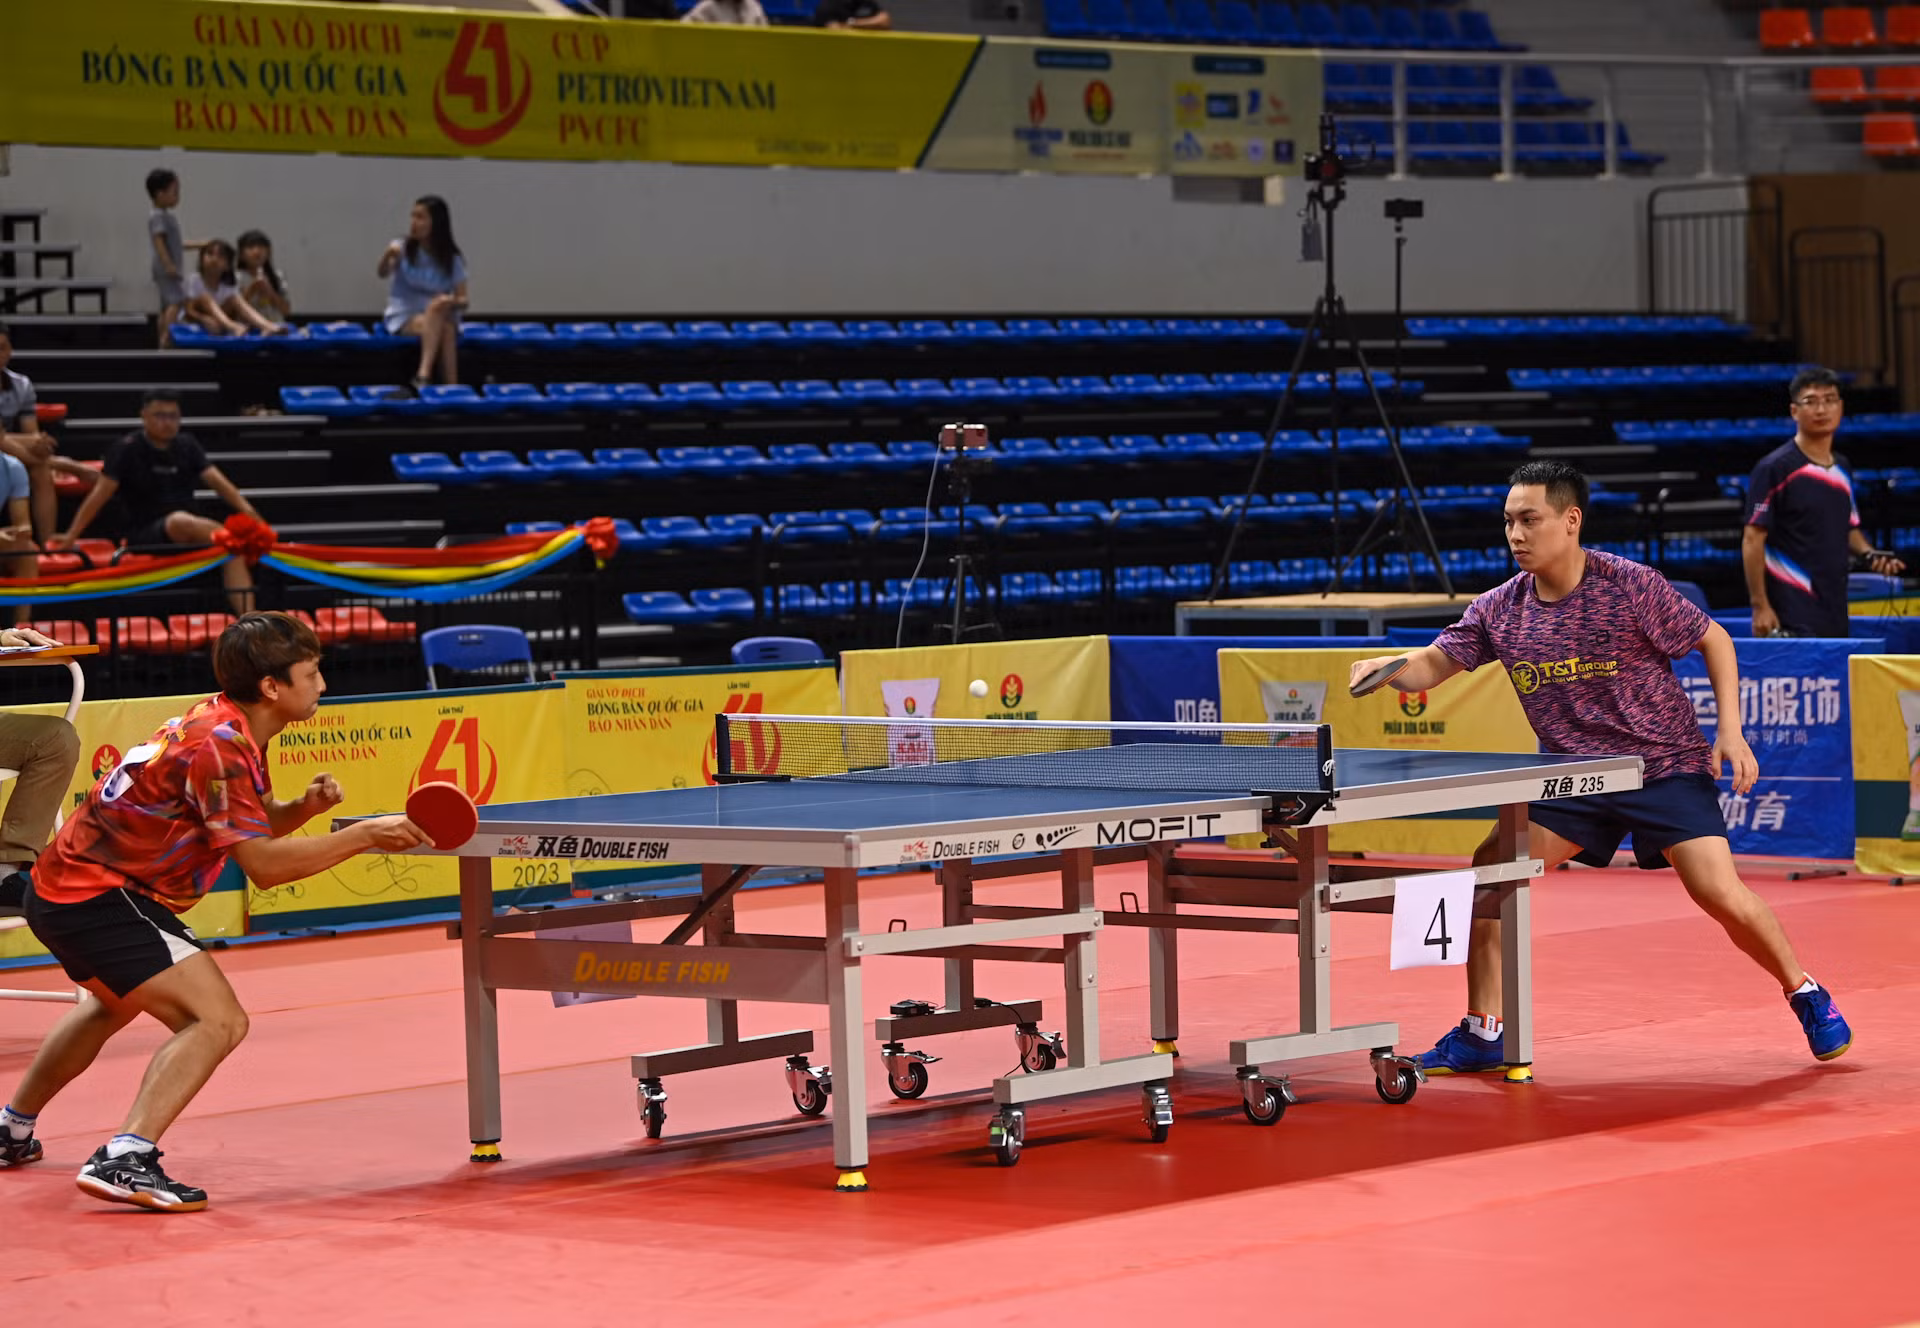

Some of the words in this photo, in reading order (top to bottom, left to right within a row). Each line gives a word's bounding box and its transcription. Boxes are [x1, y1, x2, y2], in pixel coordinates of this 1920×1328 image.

[82, 43, 174, 87] BÓNG
[185, 48, 248, 89] BÀN
[258, 53, 343, 97] QUỐC
[354, 63, 407, 96] GIA
[557, 71, 776, 112] PETROVIETNAM
[559, 113, 648, 146] PVCFC
[1539, 658, 1579, 677] T&T
[1578, 661, 1617, 672] GROUP
[587, 700, 620, 716] BÓNG
[621, 698, 646, 715] BÀN
[647, 696, 682, 713] QUỐC
[683, 698, 704, 712] GIA
[279, 730, 316, 747] BÓNG
[319, 727, 347, 745] BÀN
[350, 722, 387, 744] QUỐC
[389, 725, 412, 740] GIA
[279, 747, 306, 766] BÁO
[310, 745, 347, 764] NHÂN
[351, 745, 378, 762] DÂN
[1541, 775, 1574, 799] 双鱼
[1579, 776, 1604, 793] 235
[1097, 813, 1221, 845] MOFIT
[534, 835, 580, 858] 双鱼
[579, 837, 636, 858] DOUBLE
[637, 841, 669, 859] FISH
[932, 841, 976, 859] DOUBLE
[977, 839, 1000, 854] FISH
[513, 862, 561, 888] 2023
[1424, 897, 1452, 960] 4
[574, 951, 671, 983] DOUBLE
[676, 961, 730, 983] FISH
